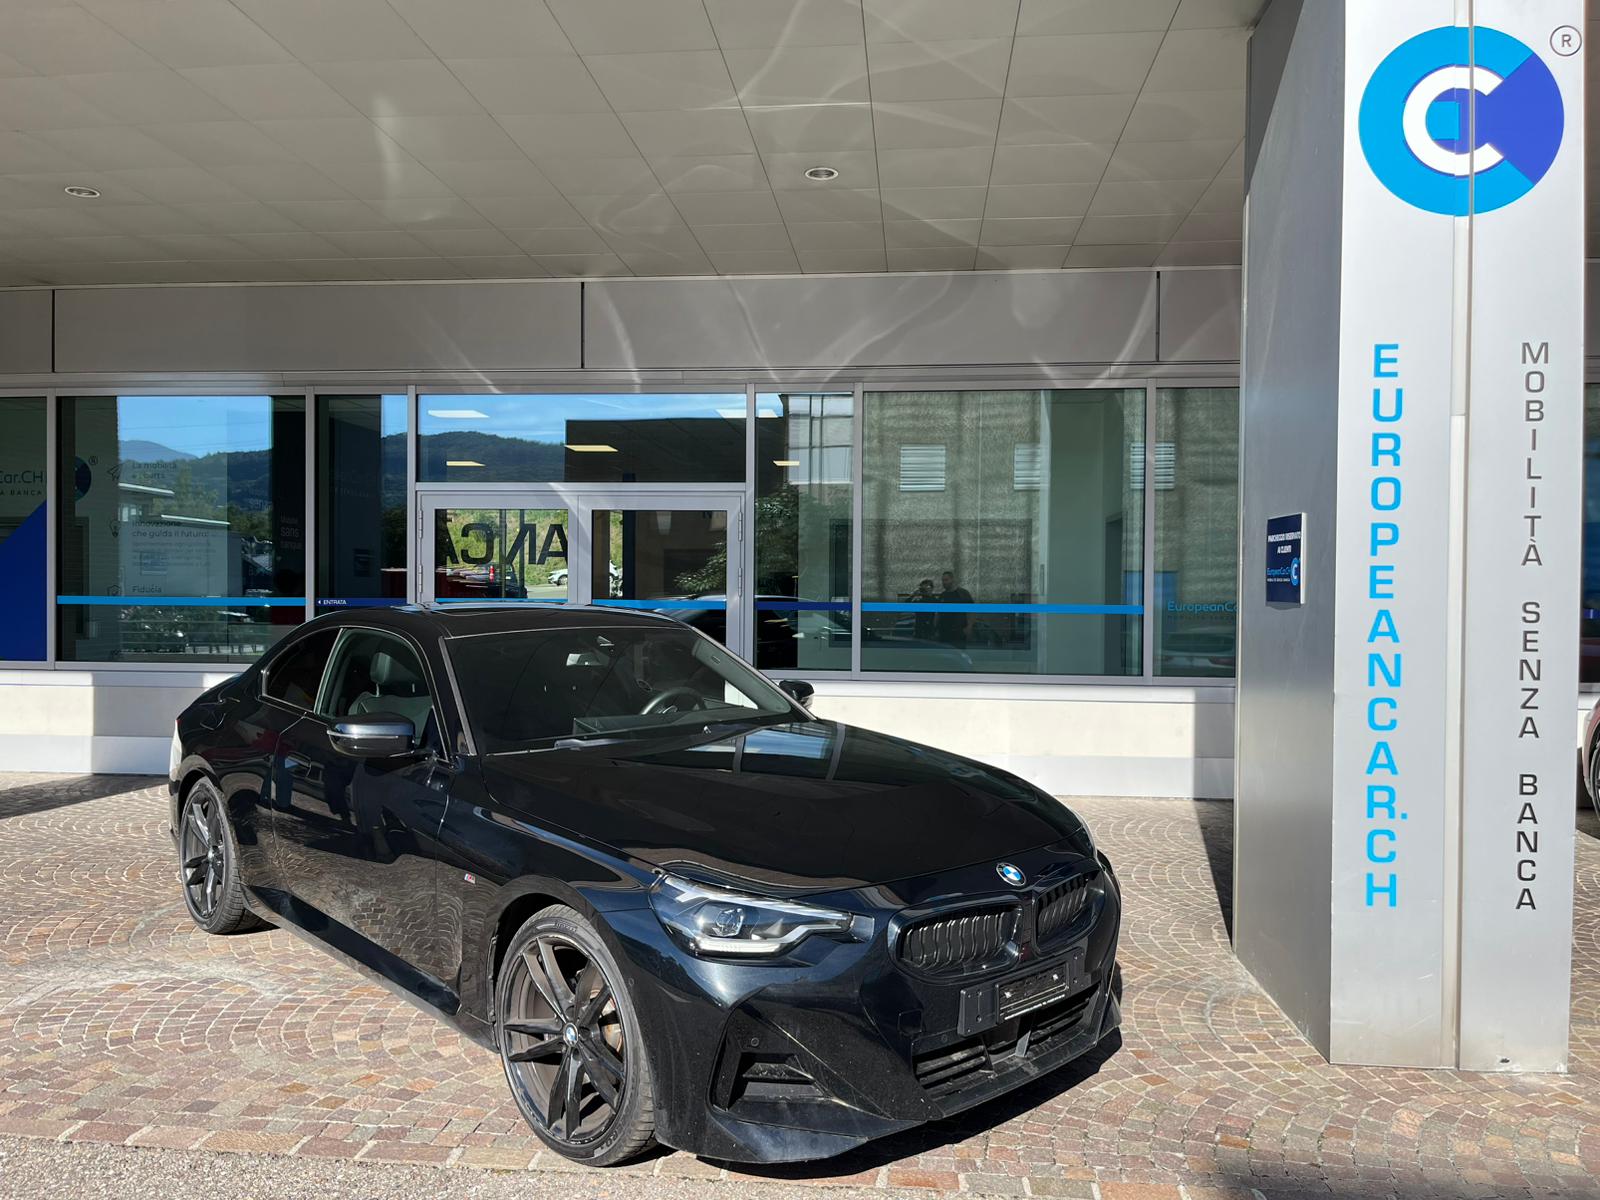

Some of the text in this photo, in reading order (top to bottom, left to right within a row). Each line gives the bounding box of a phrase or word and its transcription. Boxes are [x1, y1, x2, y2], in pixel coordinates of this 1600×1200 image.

[1365, 343, 1408, 907] EUROPEANCAR.CH
[1515, 341, 1549, 910] MOBILITÀ SENZA BANCA
